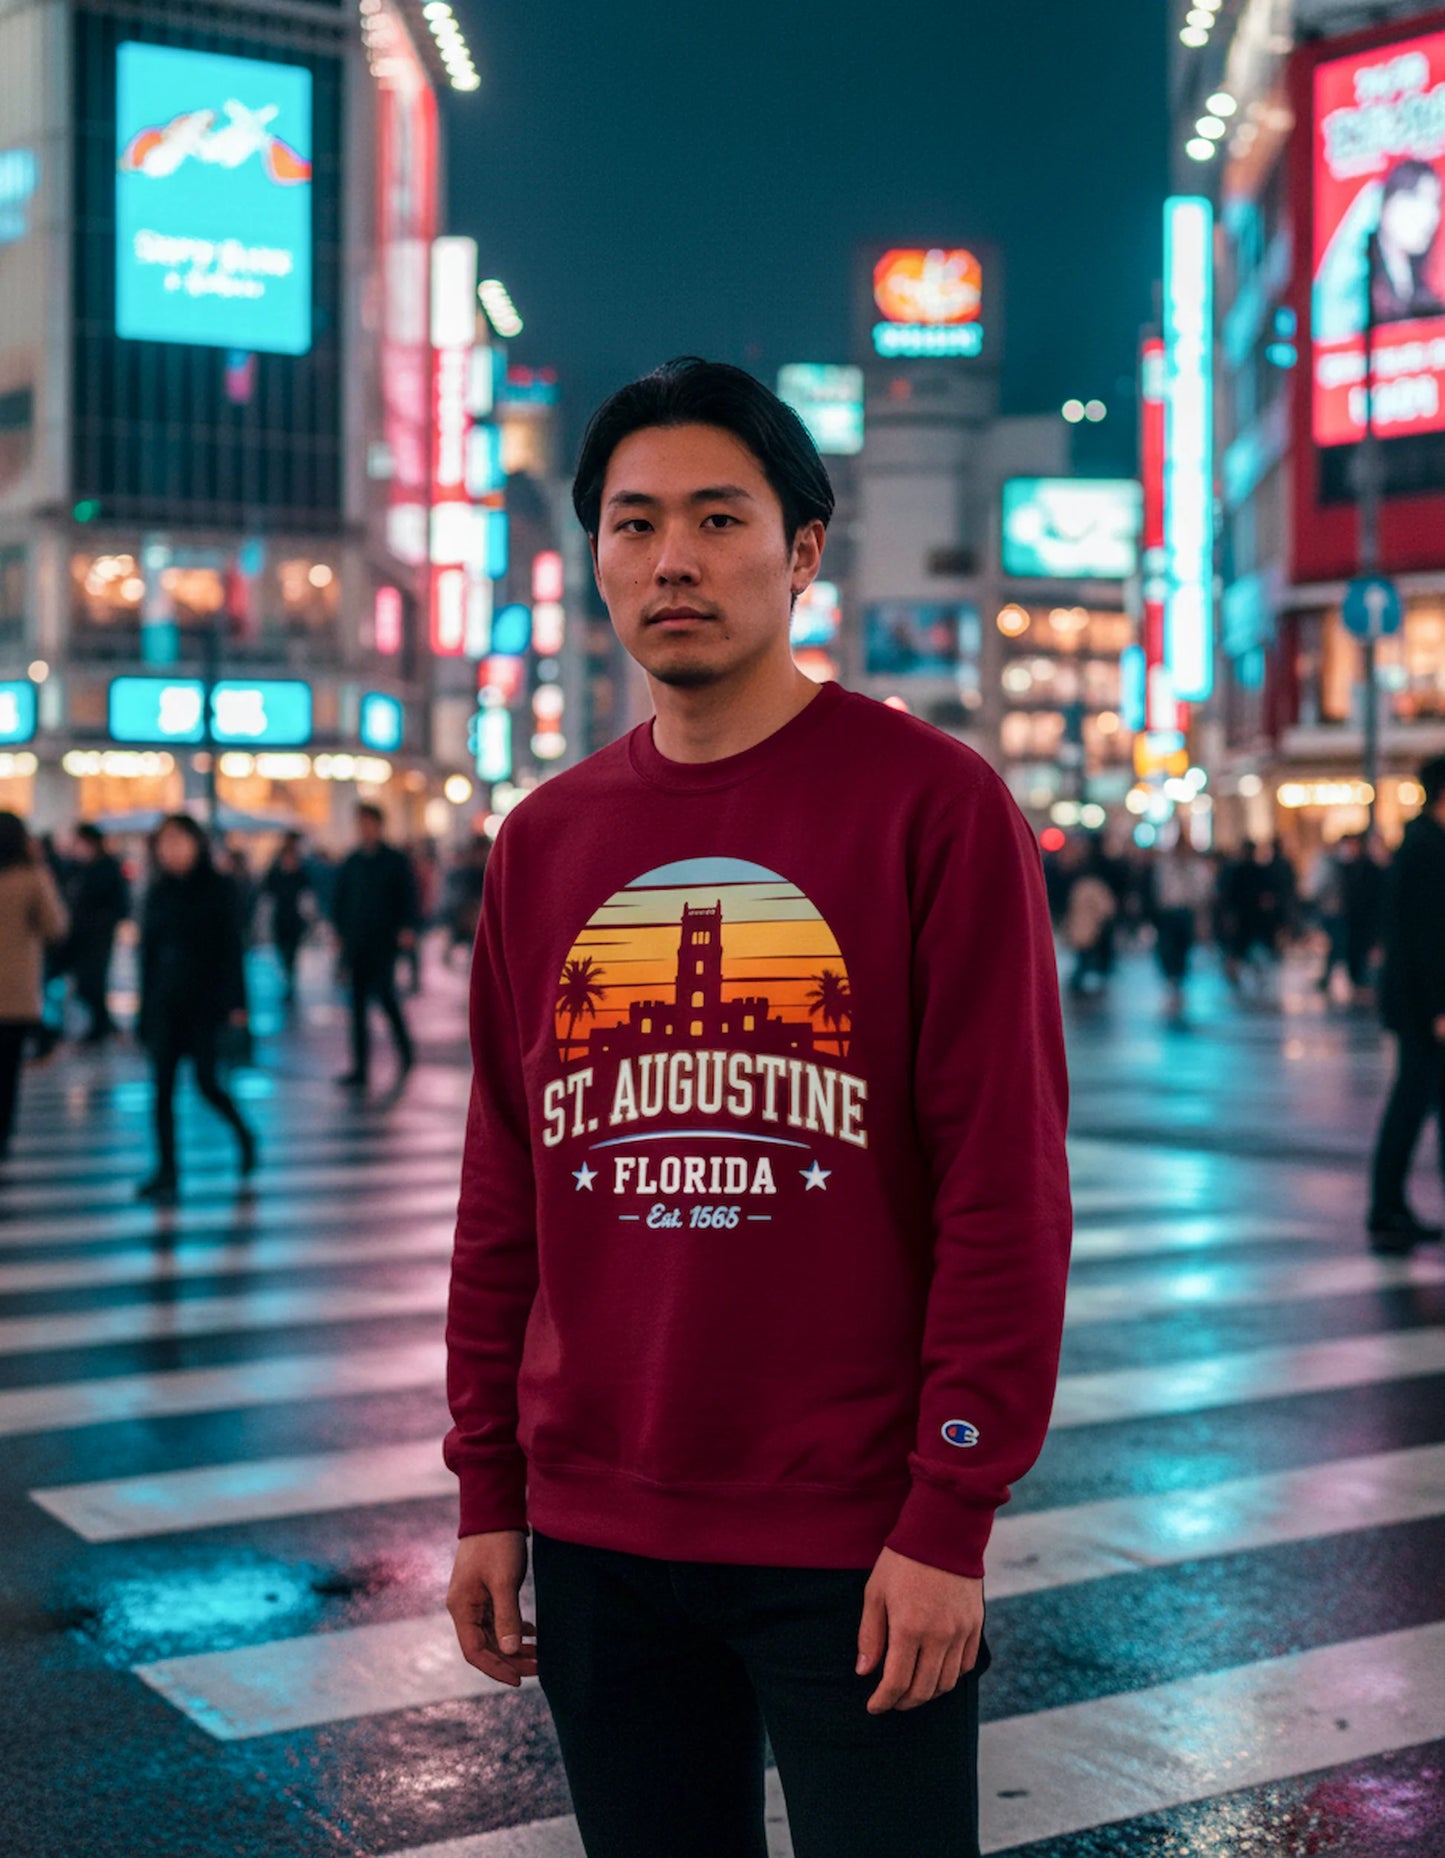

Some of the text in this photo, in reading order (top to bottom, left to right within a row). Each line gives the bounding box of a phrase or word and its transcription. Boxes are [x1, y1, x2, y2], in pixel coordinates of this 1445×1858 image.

[543, 1051, 868, 1148] ST. AUGUSTINE
[613, 1157, 776, 1194] FLORIDA
[689, 1205, 741, 1229] 1565
